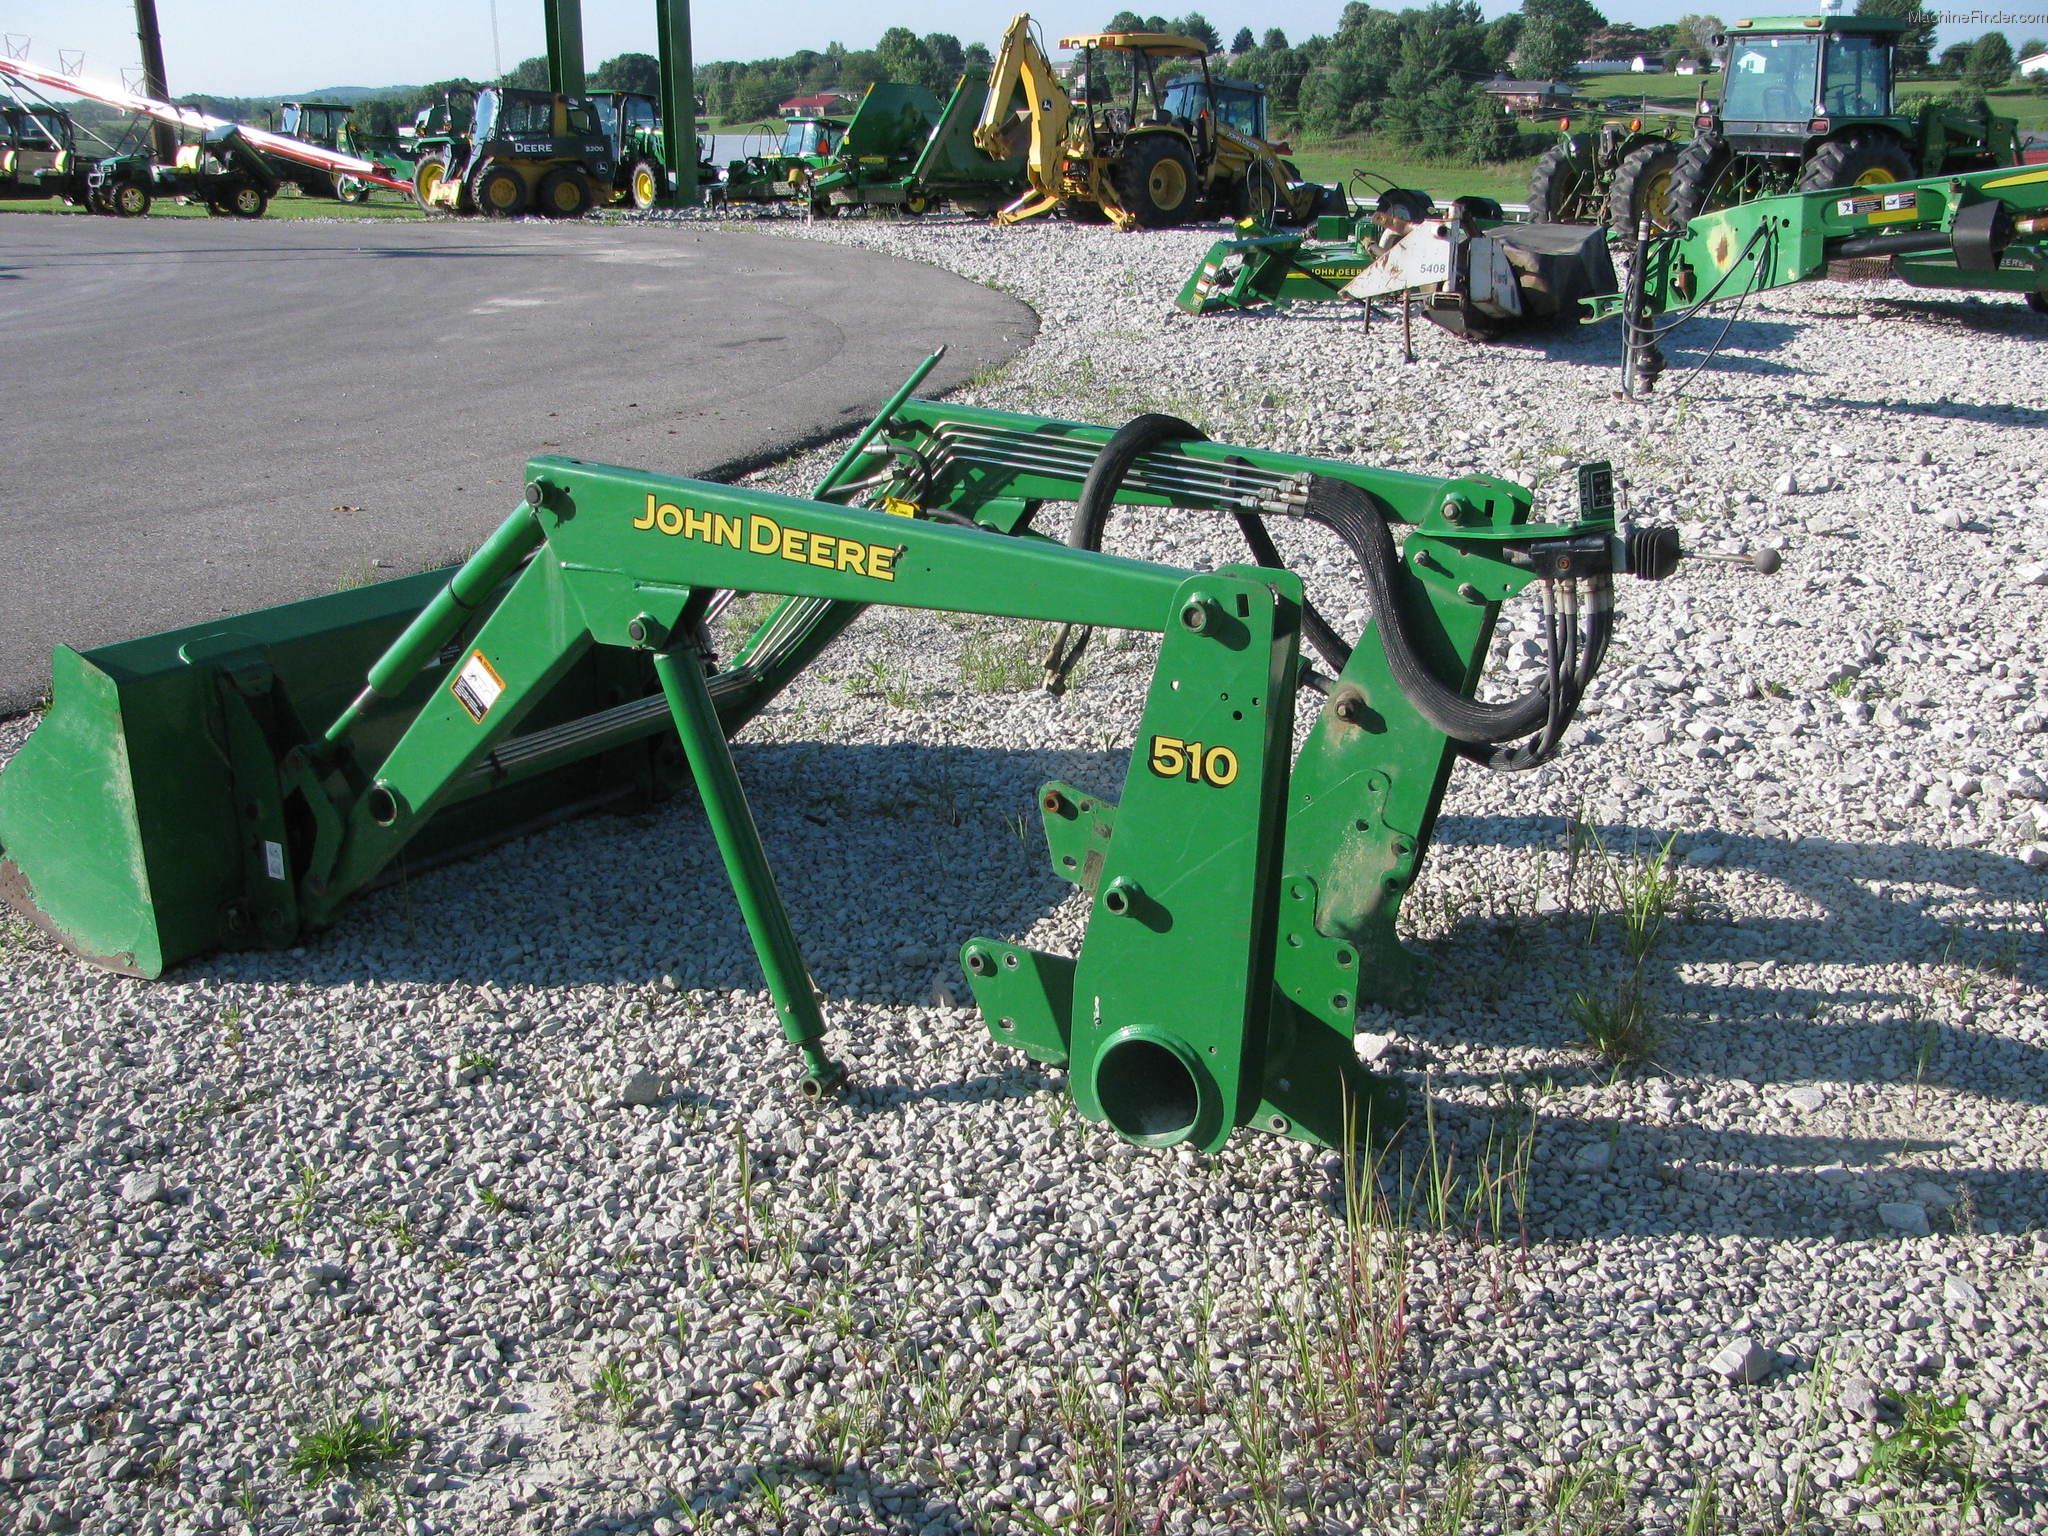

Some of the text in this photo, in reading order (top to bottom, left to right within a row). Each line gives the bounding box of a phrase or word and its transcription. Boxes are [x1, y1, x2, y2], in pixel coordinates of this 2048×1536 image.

[514, 143, 553, 153] DEERE
[2000, 257, 2025, 267] EERE
[1338, 268, 1363, 276] DEER
[1420, 263, 1446, 273] 5408
[632, 493, 896, 582] JOHN DEERE
[1147, 734, 1239, 789] 510
